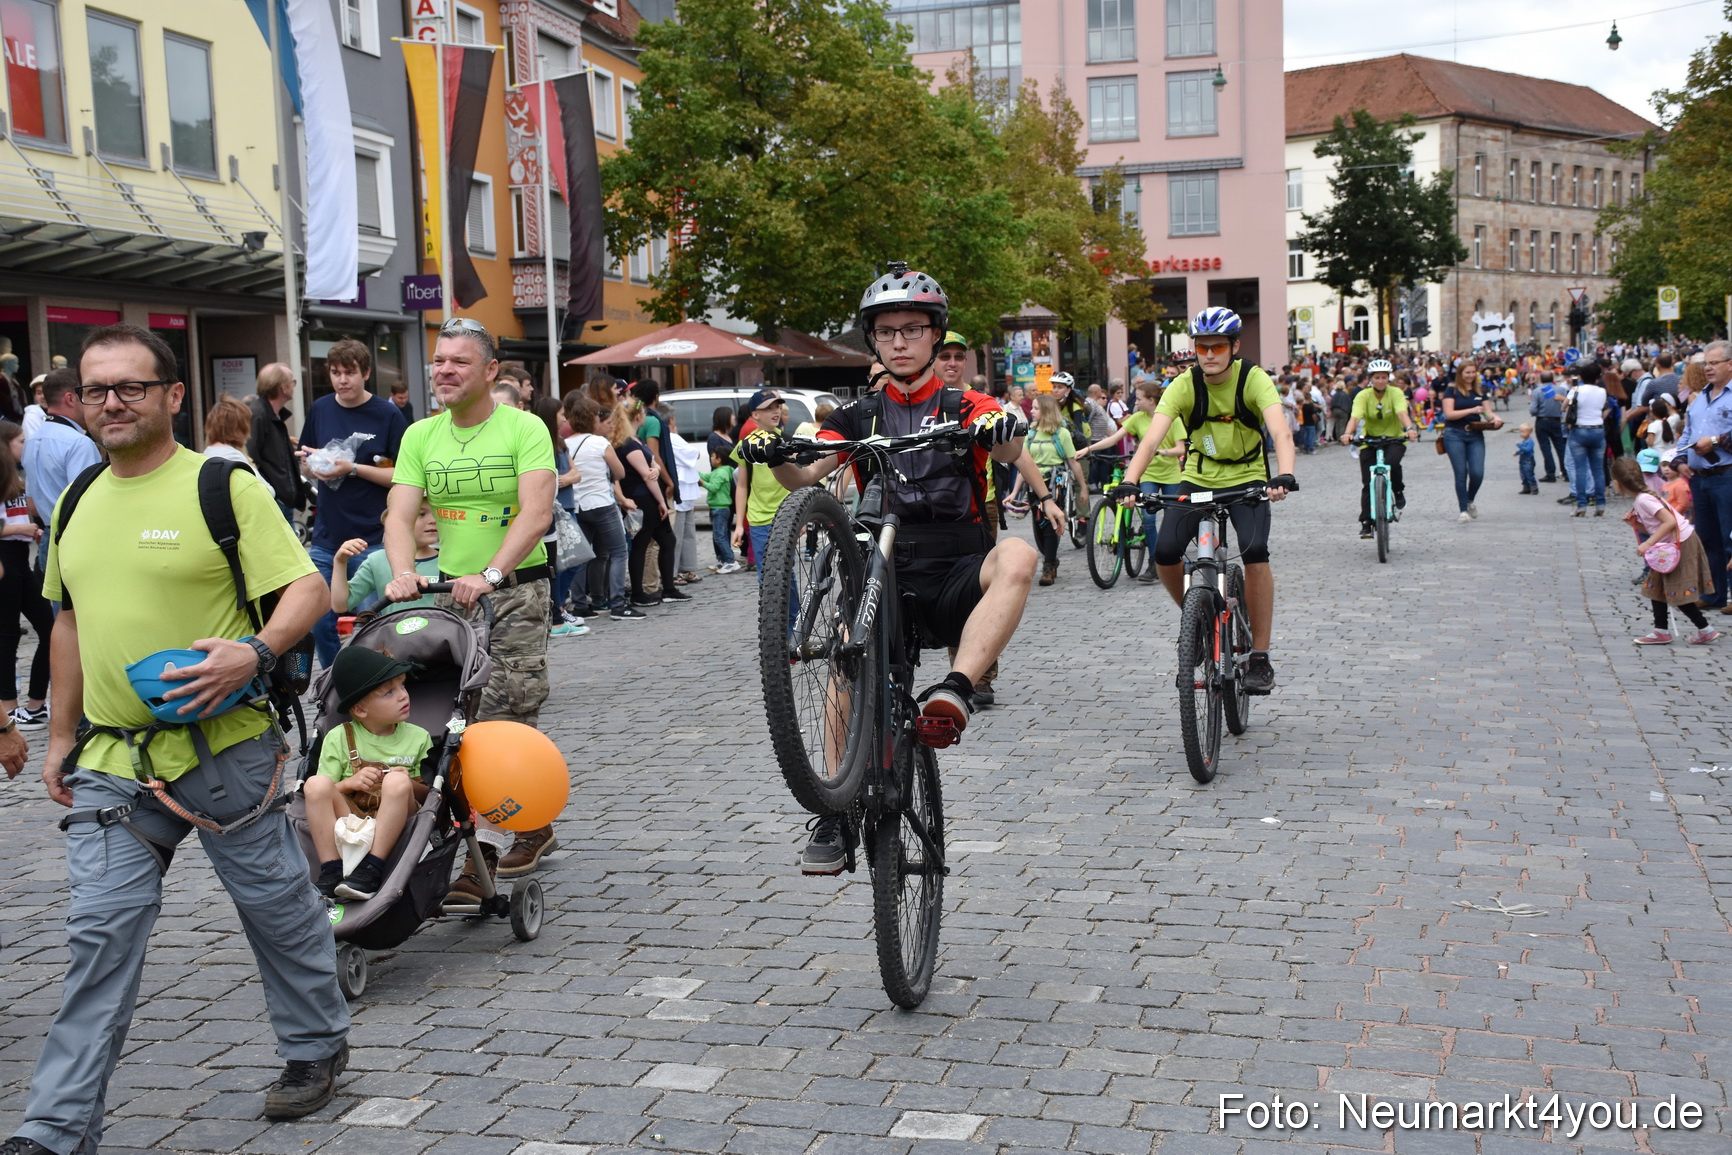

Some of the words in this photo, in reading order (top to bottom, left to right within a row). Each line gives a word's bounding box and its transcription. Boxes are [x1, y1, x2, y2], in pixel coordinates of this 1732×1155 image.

[222, 360, 244, 368] ADLER
[151, 529, 180, 540] DAV
[397, 756, 415, 764] DAV
